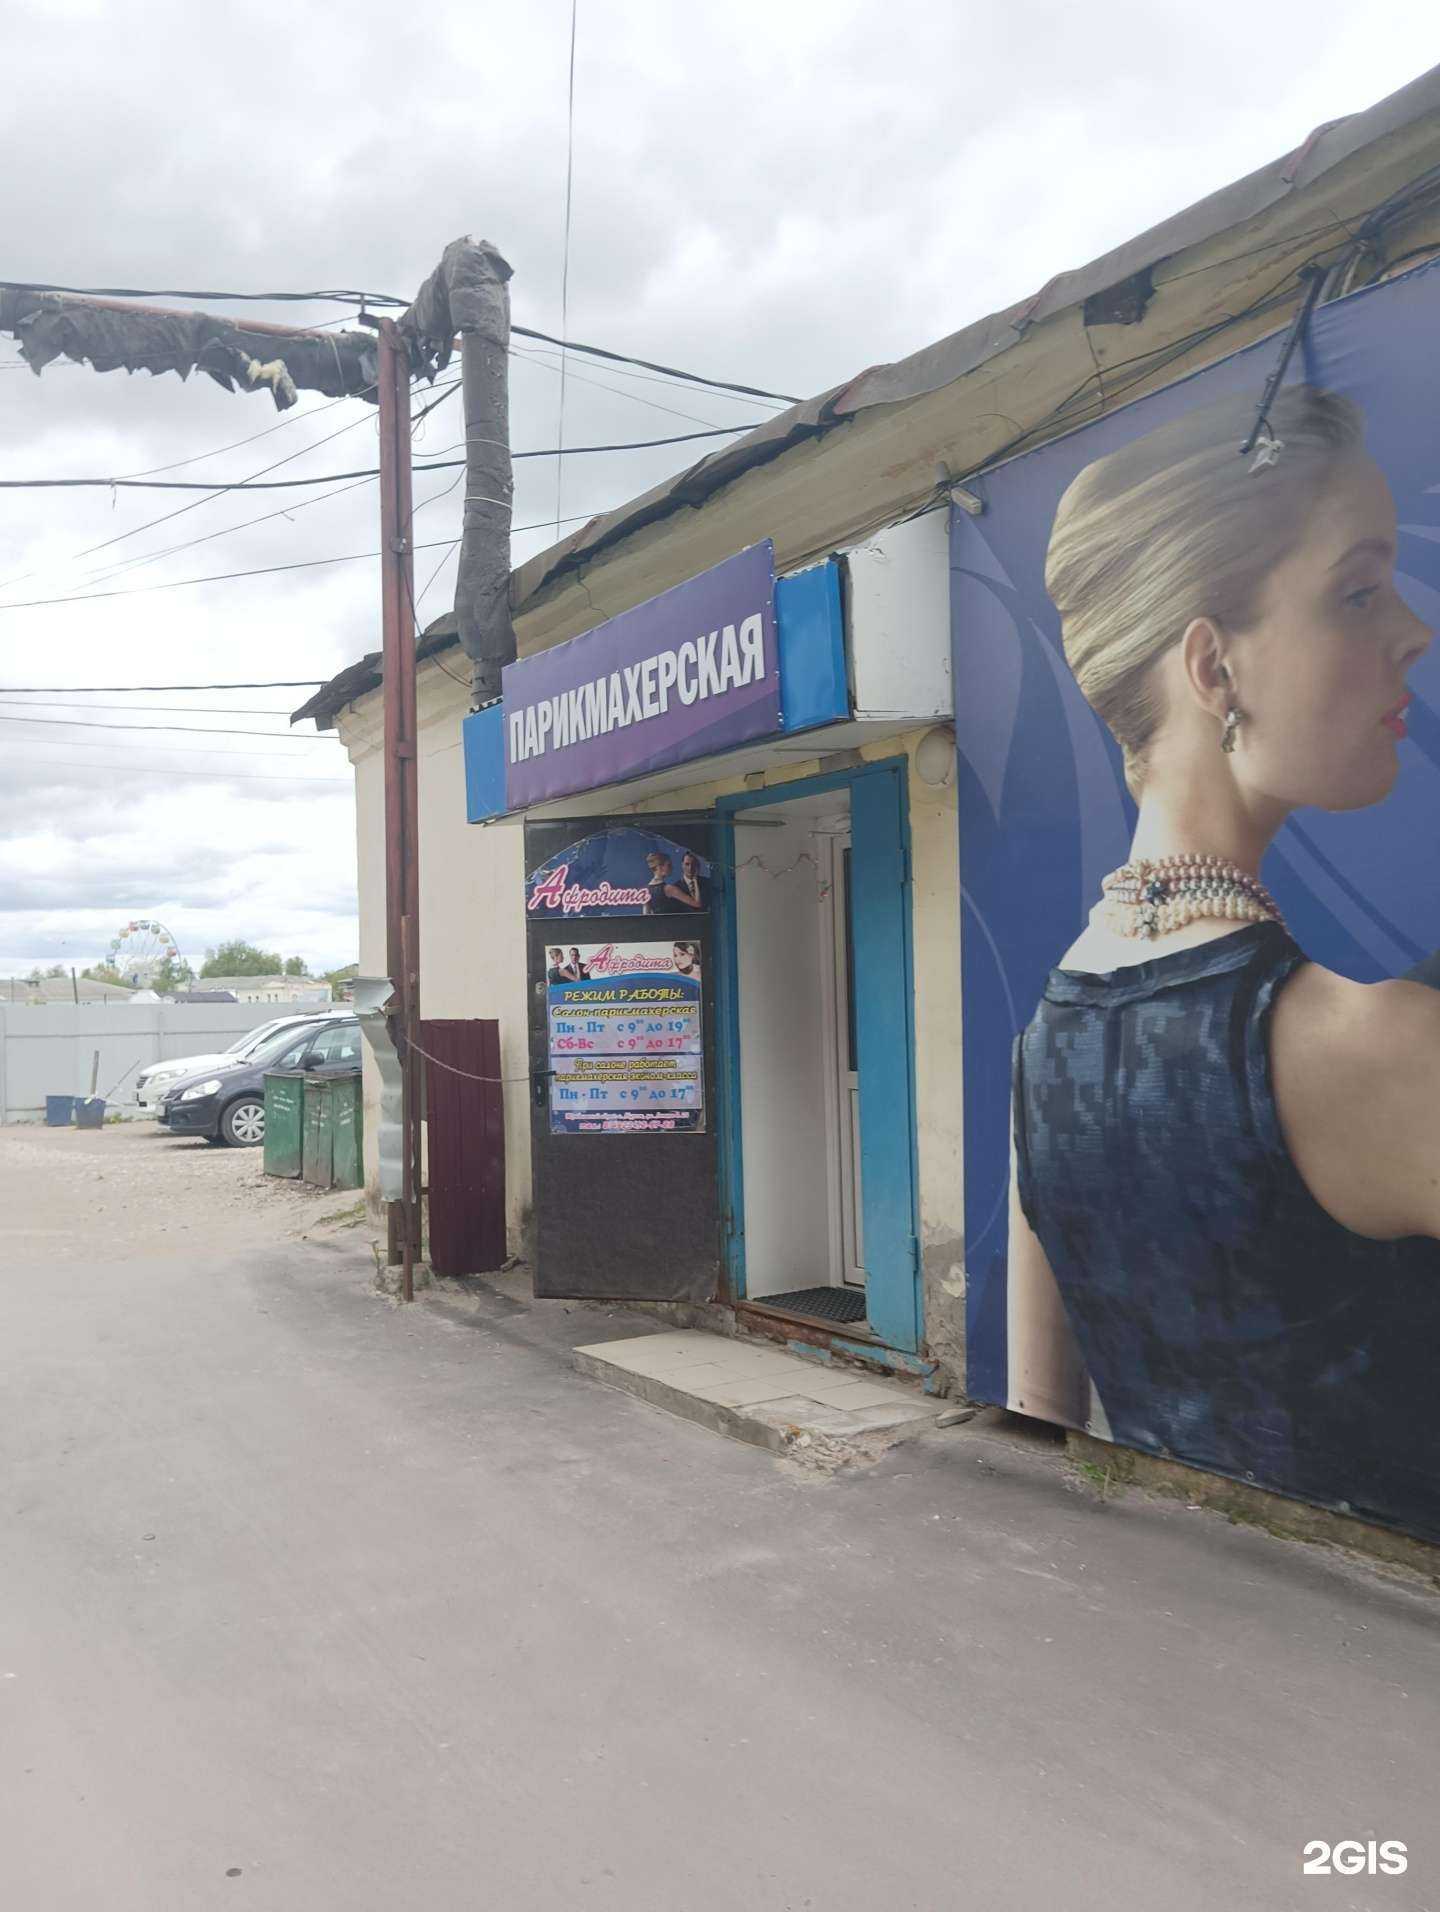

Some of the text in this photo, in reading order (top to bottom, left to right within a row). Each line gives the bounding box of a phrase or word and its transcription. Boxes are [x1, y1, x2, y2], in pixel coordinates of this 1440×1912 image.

[510, 613, 765, 764] ПАРИКМАХЕРСКАЯ
[528, 864, 651, 913] Афродита
[583, 944, 673, 976] Афродита
[564, 990, 616, 1001] РЕЖИМ
[556, 1022, 575, 1033] Пн
[587, 1021, 605, 1032] Пт
[646, 1022, 663, 1032] до
[646, 1039, 663, 1048] до
[560, 1088, 578, 1099] Пн
[590, 1088, 608, 1099] Пт
[649, 1090, 666, 1099] до
